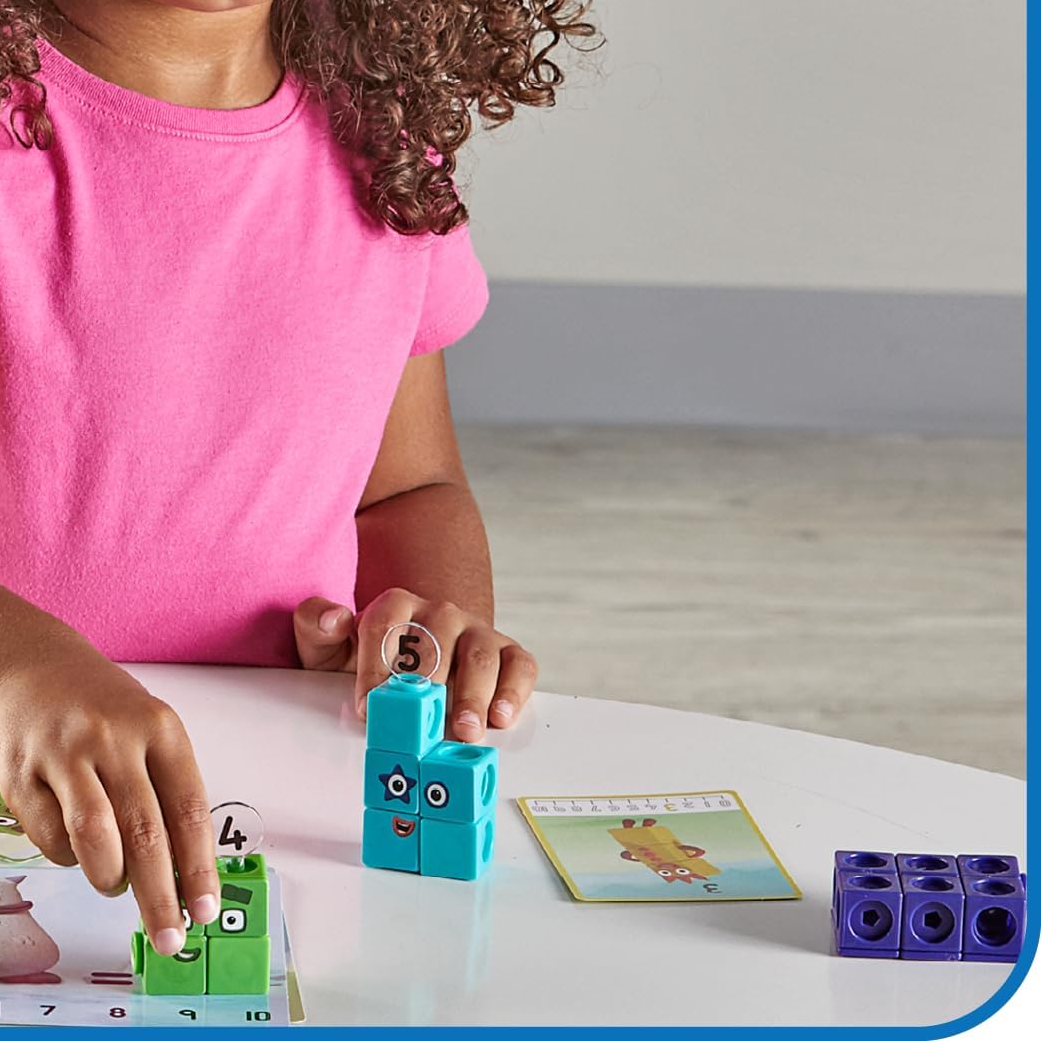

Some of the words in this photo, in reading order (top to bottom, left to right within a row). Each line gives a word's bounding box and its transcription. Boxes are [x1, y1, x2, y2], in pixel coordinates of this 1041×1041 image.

[398, 634, 421, 672] 5
[218, 815, 248, 851] 4
[39, 1005, 57, 1016] 7
[109, 1007, 127, 1019] 8
[178, 1009, 197, 1021] 9
[245, 1010, 271, 1022] 10
